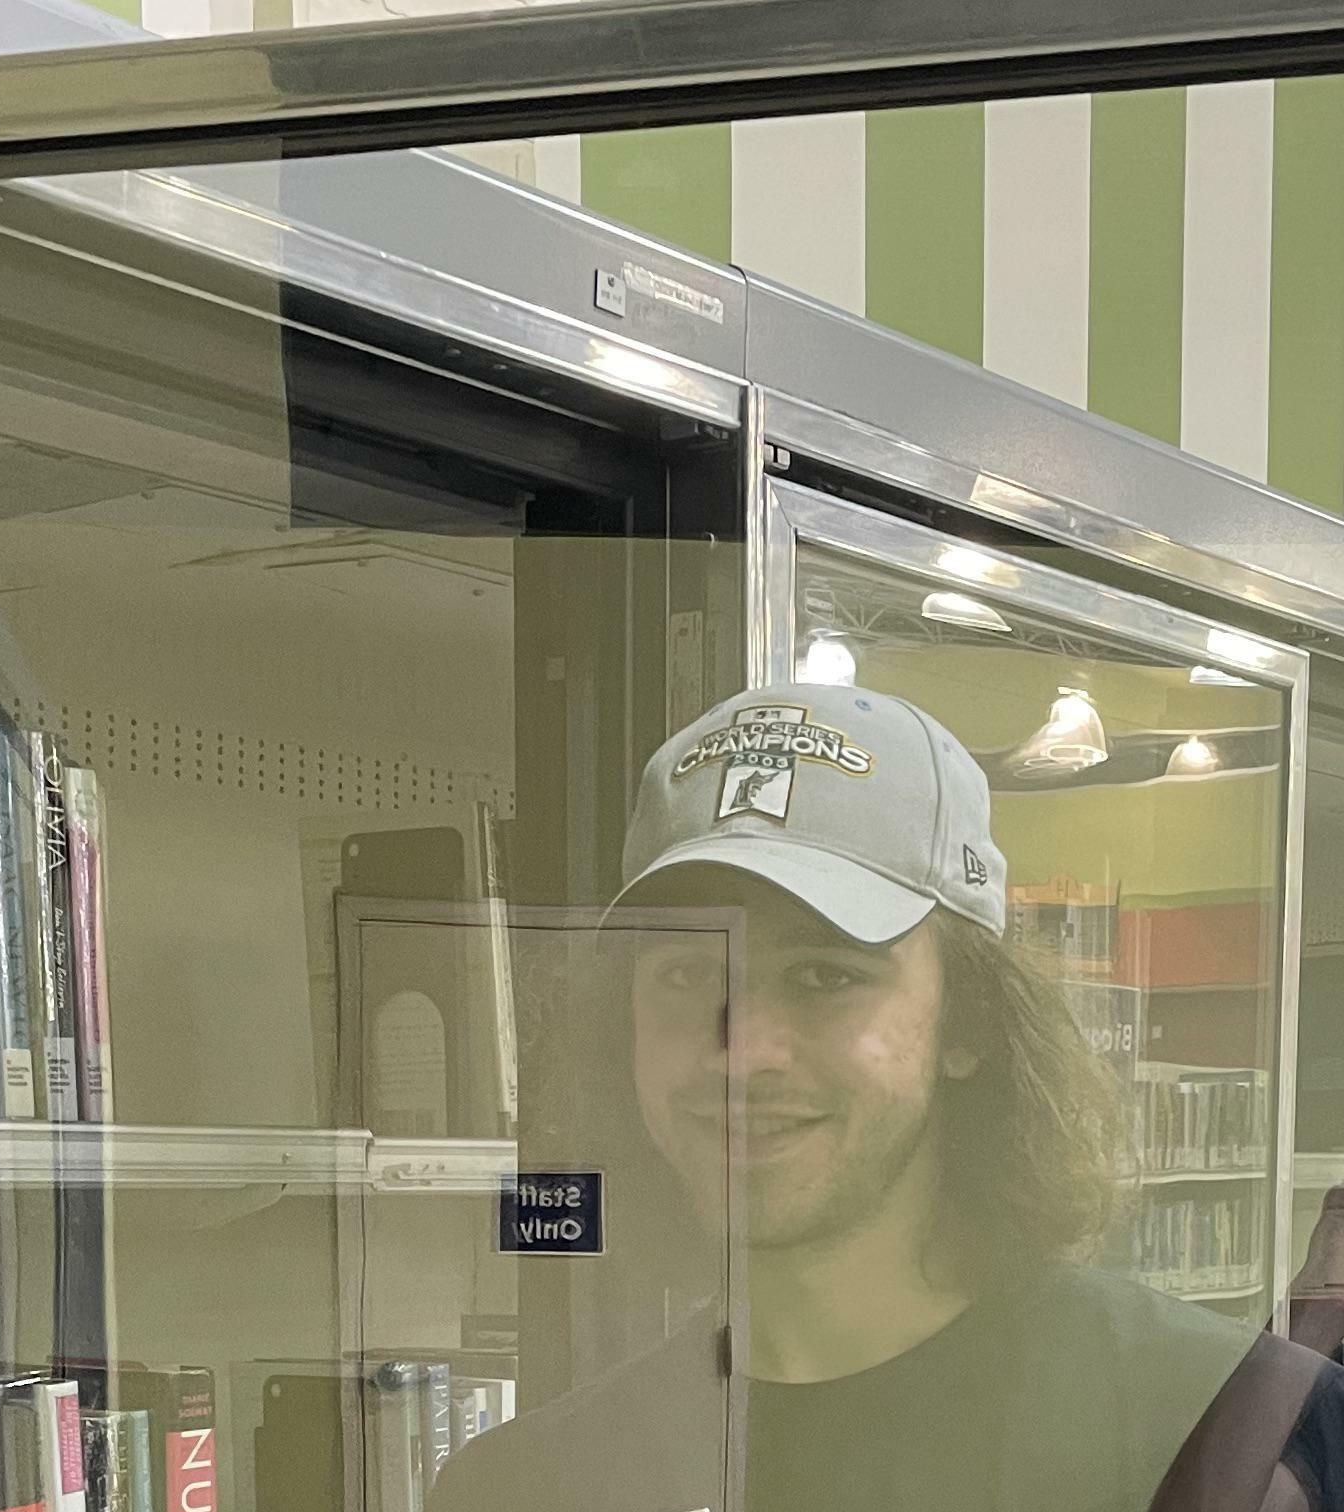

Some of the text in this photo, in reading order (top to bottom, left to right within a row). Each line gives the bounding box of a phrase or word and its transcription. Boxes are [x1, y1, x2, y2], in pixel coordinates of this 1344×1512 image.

[675, 733, 872, 775] CHAMPIONS
[703, 722, 841, 746] WORLD SERIES
[44, 755, 67, 870] OLIVIA
